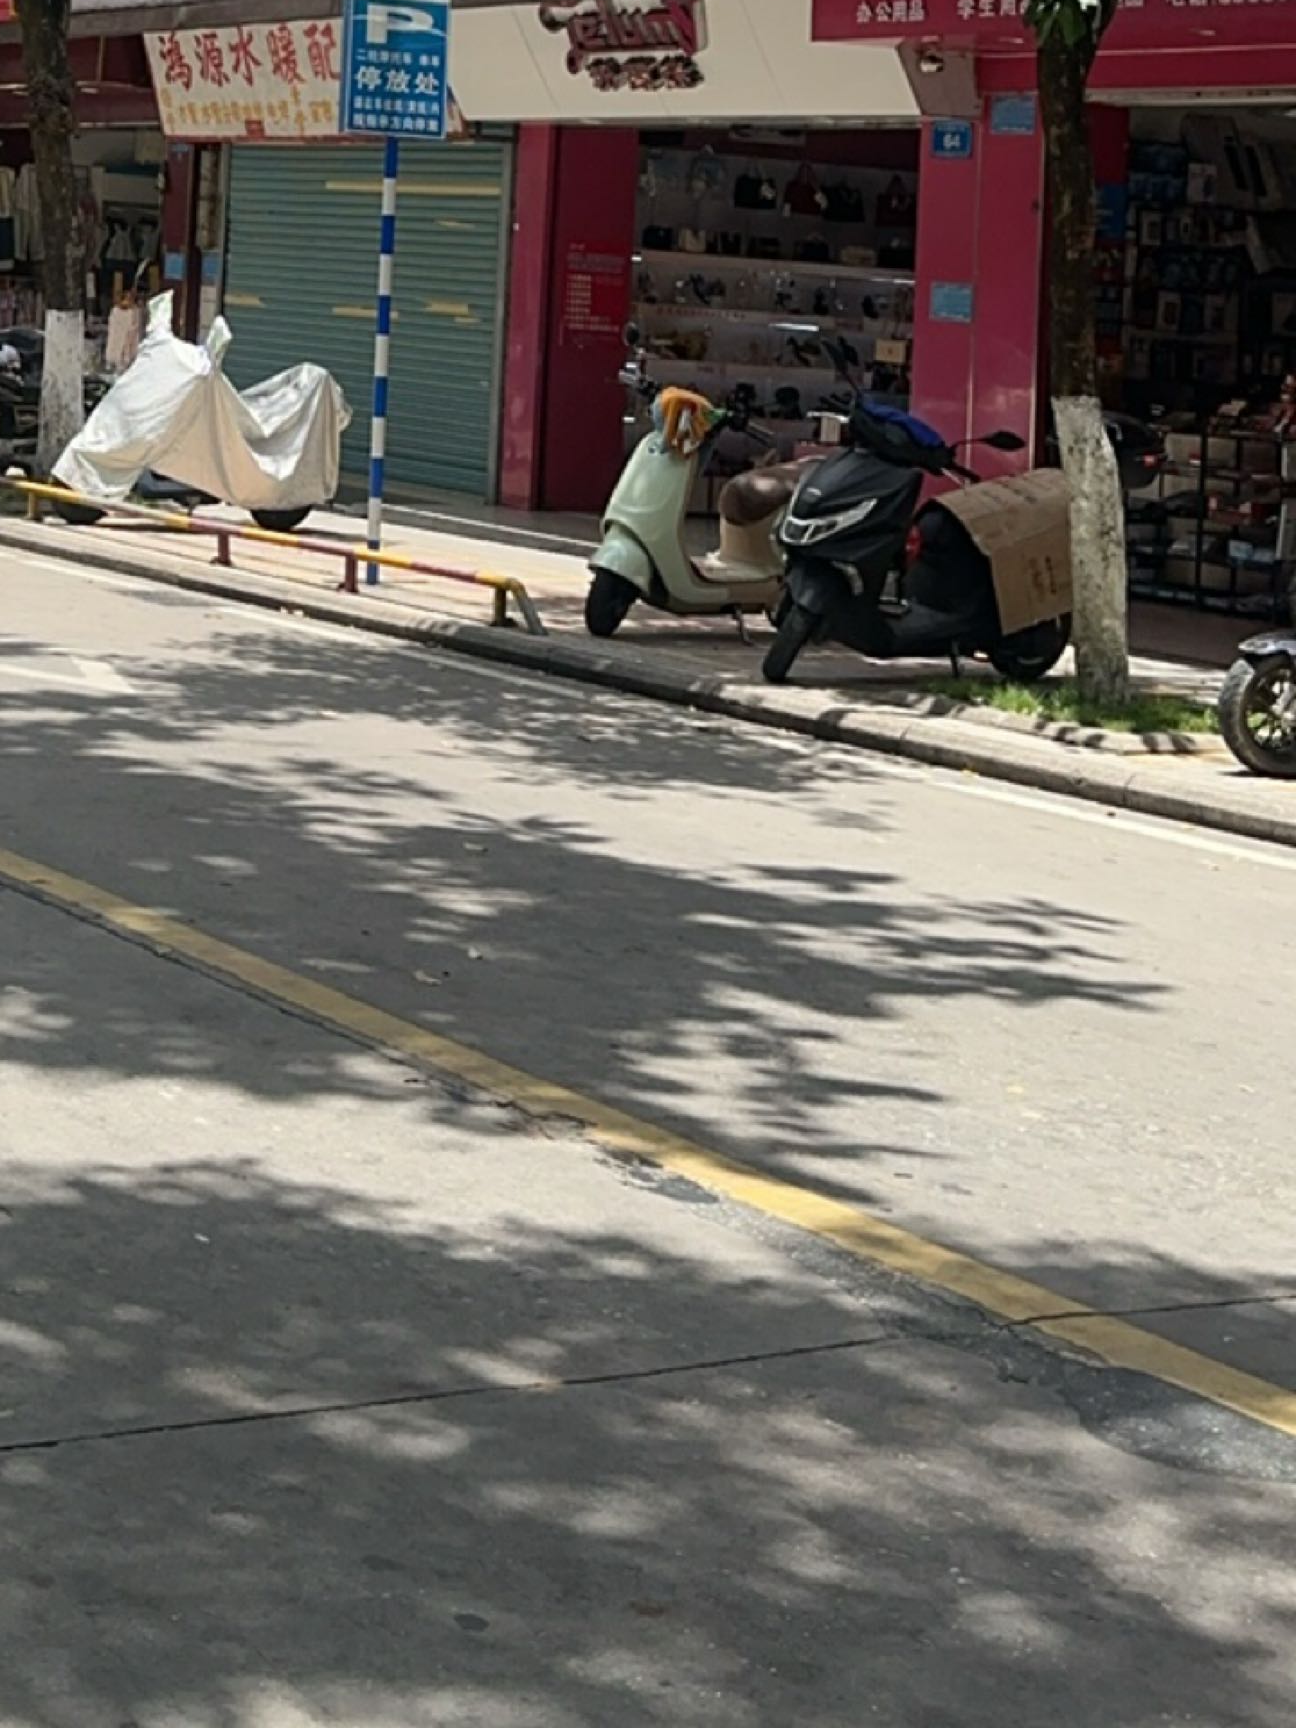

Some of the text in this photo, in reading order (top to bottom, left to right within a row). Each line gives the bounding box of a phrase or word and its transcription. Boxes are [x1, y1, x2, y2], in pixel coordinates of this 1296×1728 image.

[856, 0, 925, 23] 办公用品
[355, 65, 440, 96] 停放处
